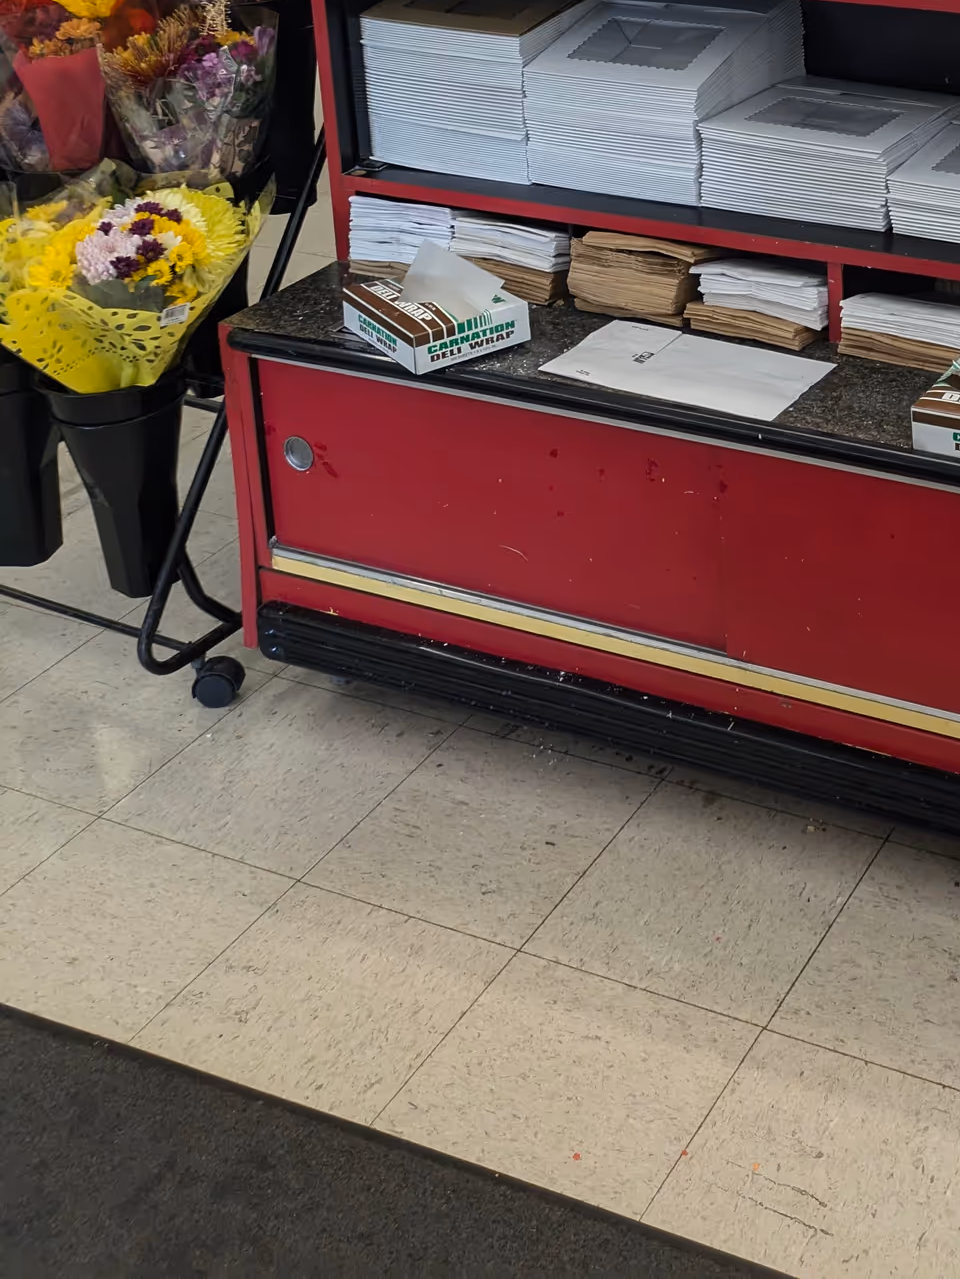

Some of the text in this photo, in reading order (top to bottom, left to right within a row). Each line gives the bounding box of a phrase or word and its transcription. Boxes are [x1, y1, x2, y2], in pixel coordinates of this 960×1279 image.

[370, 285, 398, 300] DELI
[394, 302, 433, 321] WRAP
[358, 314, 397, 347] CARNATION
[360, 323, 397, 353] DELI WRAP
[427, 320, 516, 355] CARNATION
[430, 347, 462, 363] DELI
[469, 330, 514, 350] WRAP
